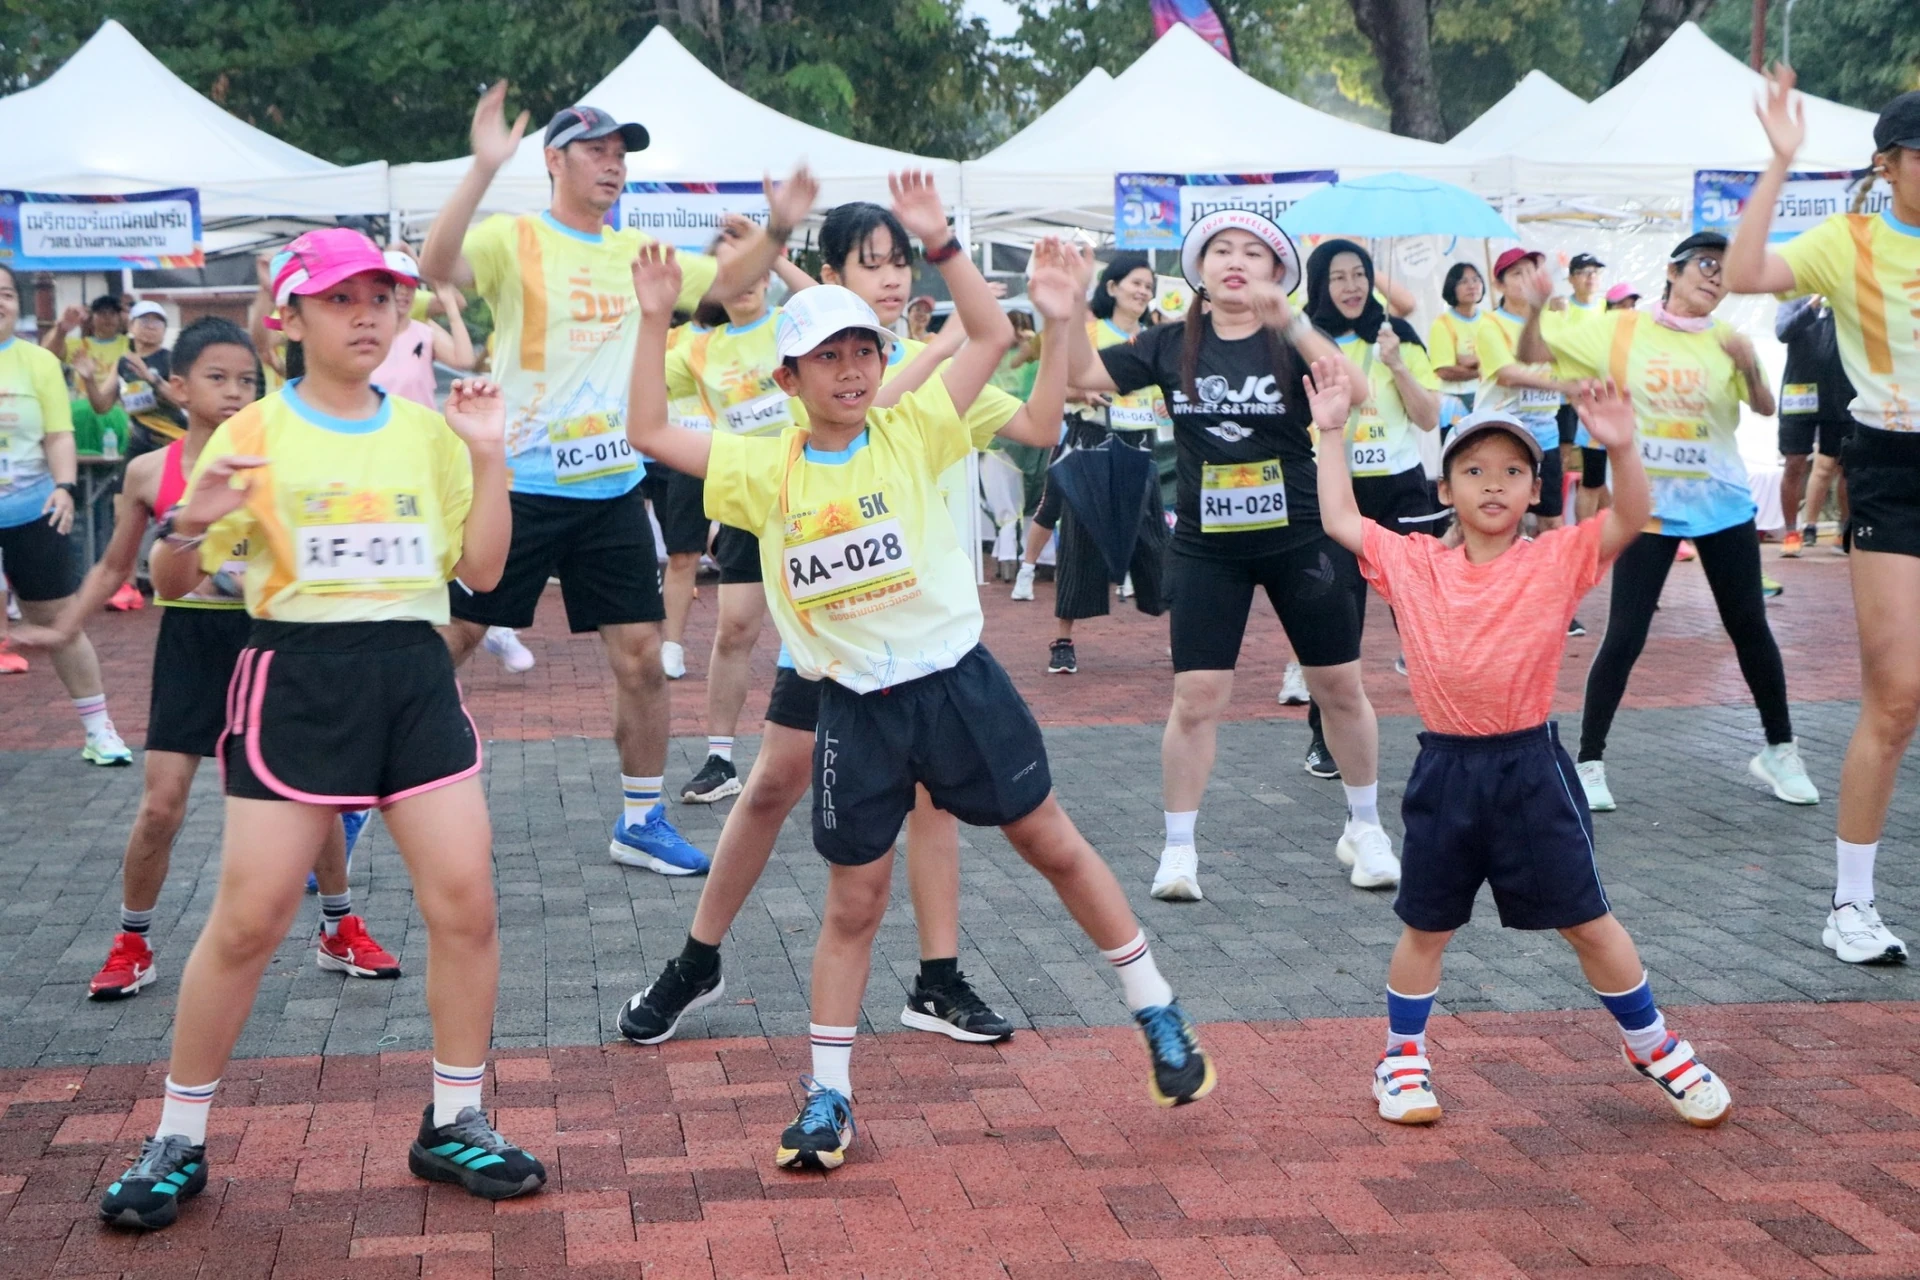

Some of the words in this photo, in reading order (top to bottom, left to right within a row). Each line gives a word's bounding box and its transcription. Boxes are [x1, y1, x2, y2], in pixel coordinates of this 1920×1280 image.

[1369, 426, 1385, 438] 5K
[569, 438, 631, 466] C-010
[1263, 465, 1280, 481] 5K
[857, 491, 889, 519] 5K
[1217, 493, 1284, 517] H-028
[329, 536, 425, 567] F-011
[809, 533, 903, 585] A-028
[823, 729, 839, 830] SPORT
